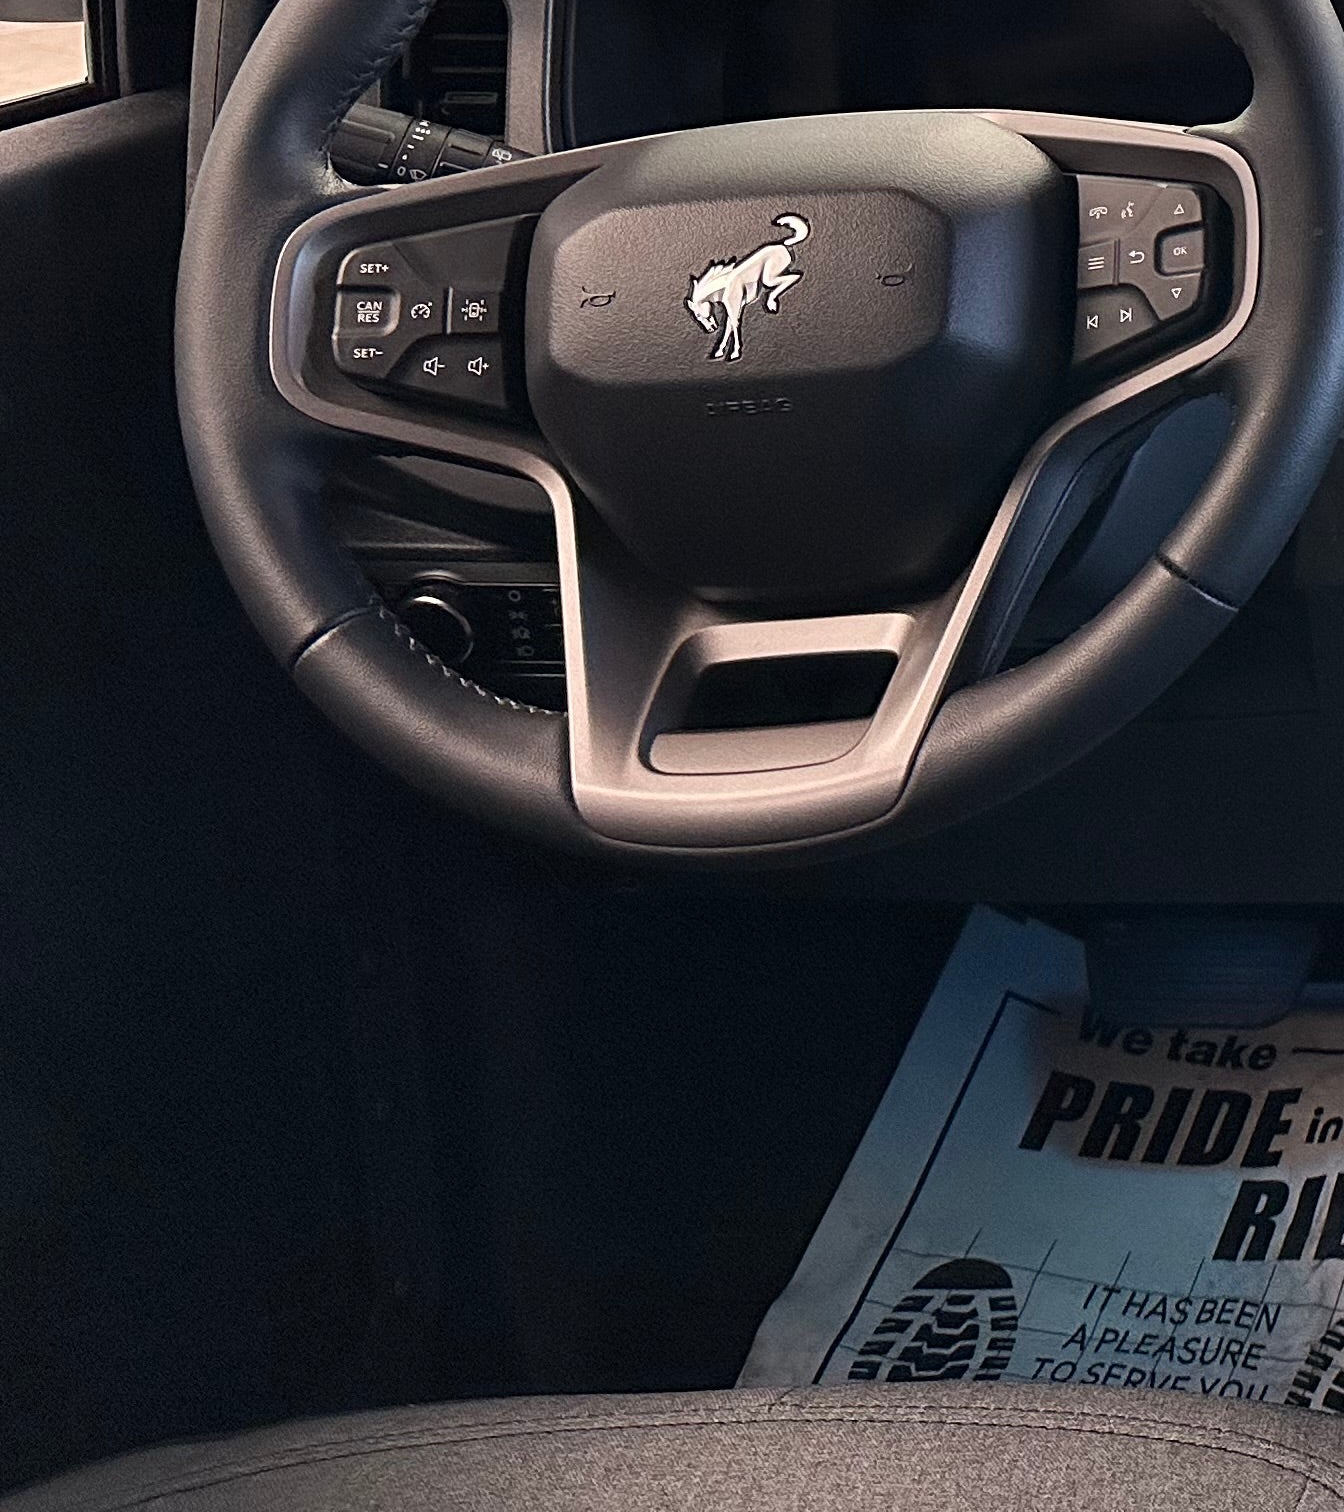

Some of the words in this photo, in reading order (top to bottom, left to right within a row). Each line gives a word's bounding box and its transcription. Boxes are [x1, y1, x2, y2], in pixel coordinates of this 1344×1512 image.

[1173, 246, 1188, 256] OK
[356, 300, 383, 311] CAN
[356, 312, 380, 323] RES
[704, 397, 793, 416] AIRBAG
[1077, 1011, 1154, 1057] We
[1166, 1029, 1278, 1071] take
[1018, 1070, 1302, 1169] PRIDE
[1305, 1106, 1343, 1145] in
[1083, 1284, 1123, 1312] IT
[1123, 1288, 1192, 1326] HAS
[1195, 1299, 1281, 1334] BEEN
[1062, 1323, 1091, 1352] A
[1093, 1327, 1268, 1371] PLEASURE
[1032, 1356, 1076, 1384] TO
[1080, 1361, 1192, 1394] SERVE
